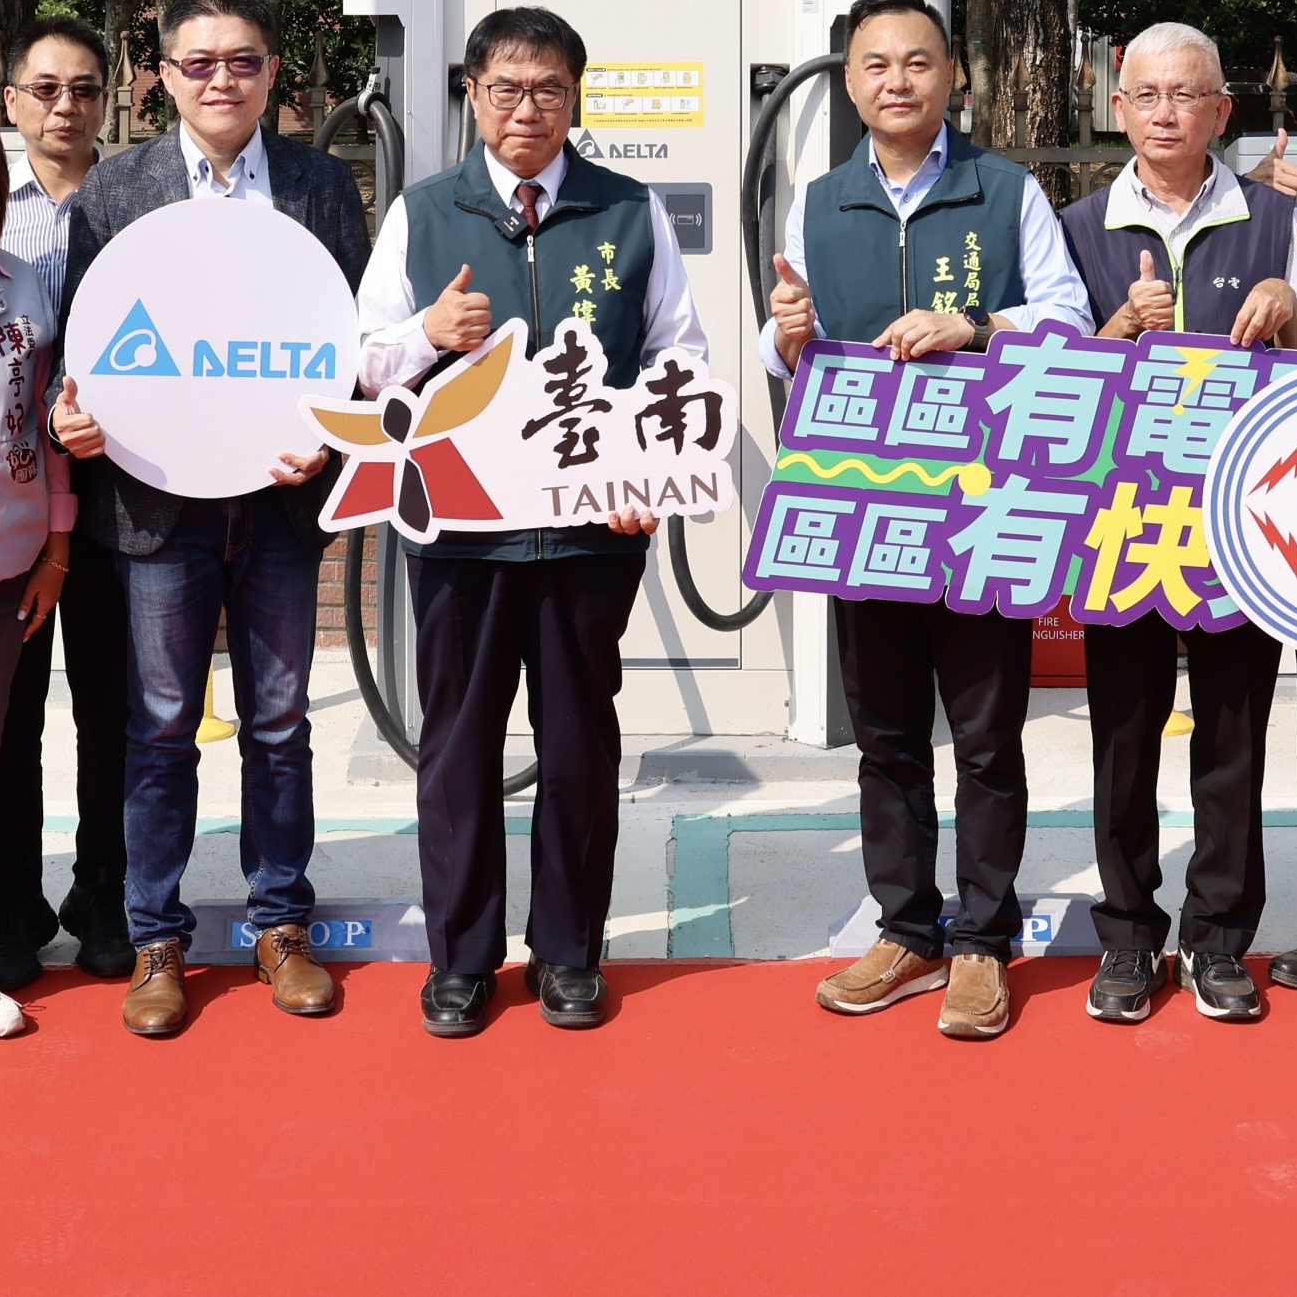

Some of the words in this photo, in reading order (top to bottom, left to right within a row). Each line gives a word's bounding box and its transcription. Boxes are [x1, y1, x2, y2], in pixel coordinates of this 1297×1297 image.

[609, 143, 668, 159] DELTA
[597, 241, 621, 291] 市長
[1212, 276, 1241, 291] 台電
[20, 314, 36, 360] 立法委
[192, 339, 336, 380] DELTA
[521, 330, 723, 470] 臺南
[542, 472, 720, 518] TAINAN
[755, 477, 1248, 620] 區區有快
[1038, 617, 1059, 627] FIRE
[240, 921, 366, 948] SOP
